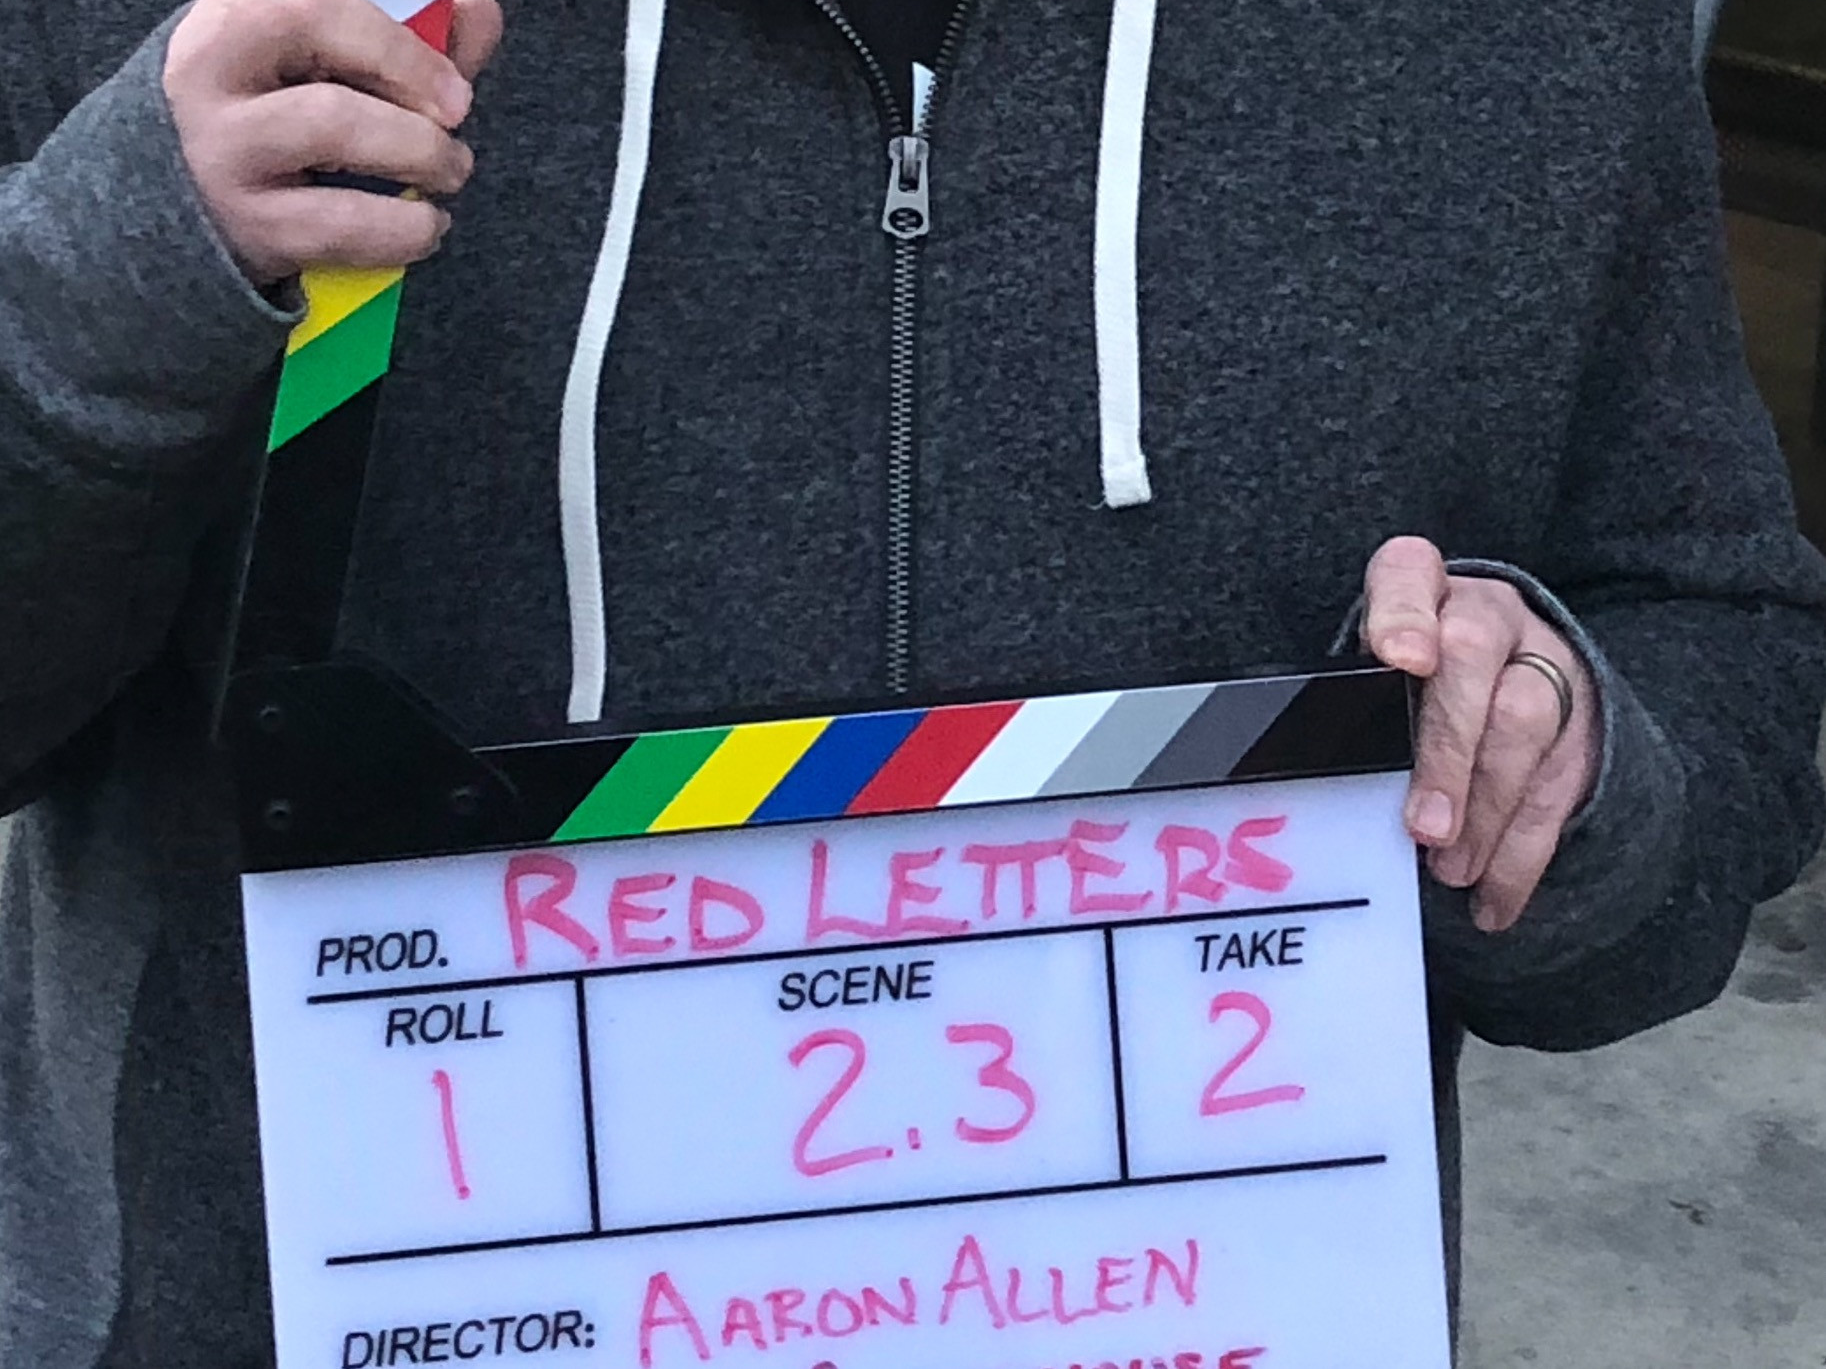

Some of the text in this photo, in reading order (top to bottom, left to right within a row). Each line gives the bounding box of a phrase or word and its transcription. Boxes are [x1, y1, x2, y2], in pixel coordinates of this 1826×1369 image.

[504, 814, 1294, 968] RED LETTERS
[315, 928, 450, 977] PROD.
[1195, 928, 1306, 972] TAKE
[778, 960, 934, 1011] SCENE
[385, 1000, 504, 1048] ROLL
[1199, 990, 1306, 1117] 2
[787, 1024, 1037, 1177] 2.3
[639, 1235, 1199, 1369] AARON ALLEN
[342, 1310, 596, 1369] DIRECTOR:
